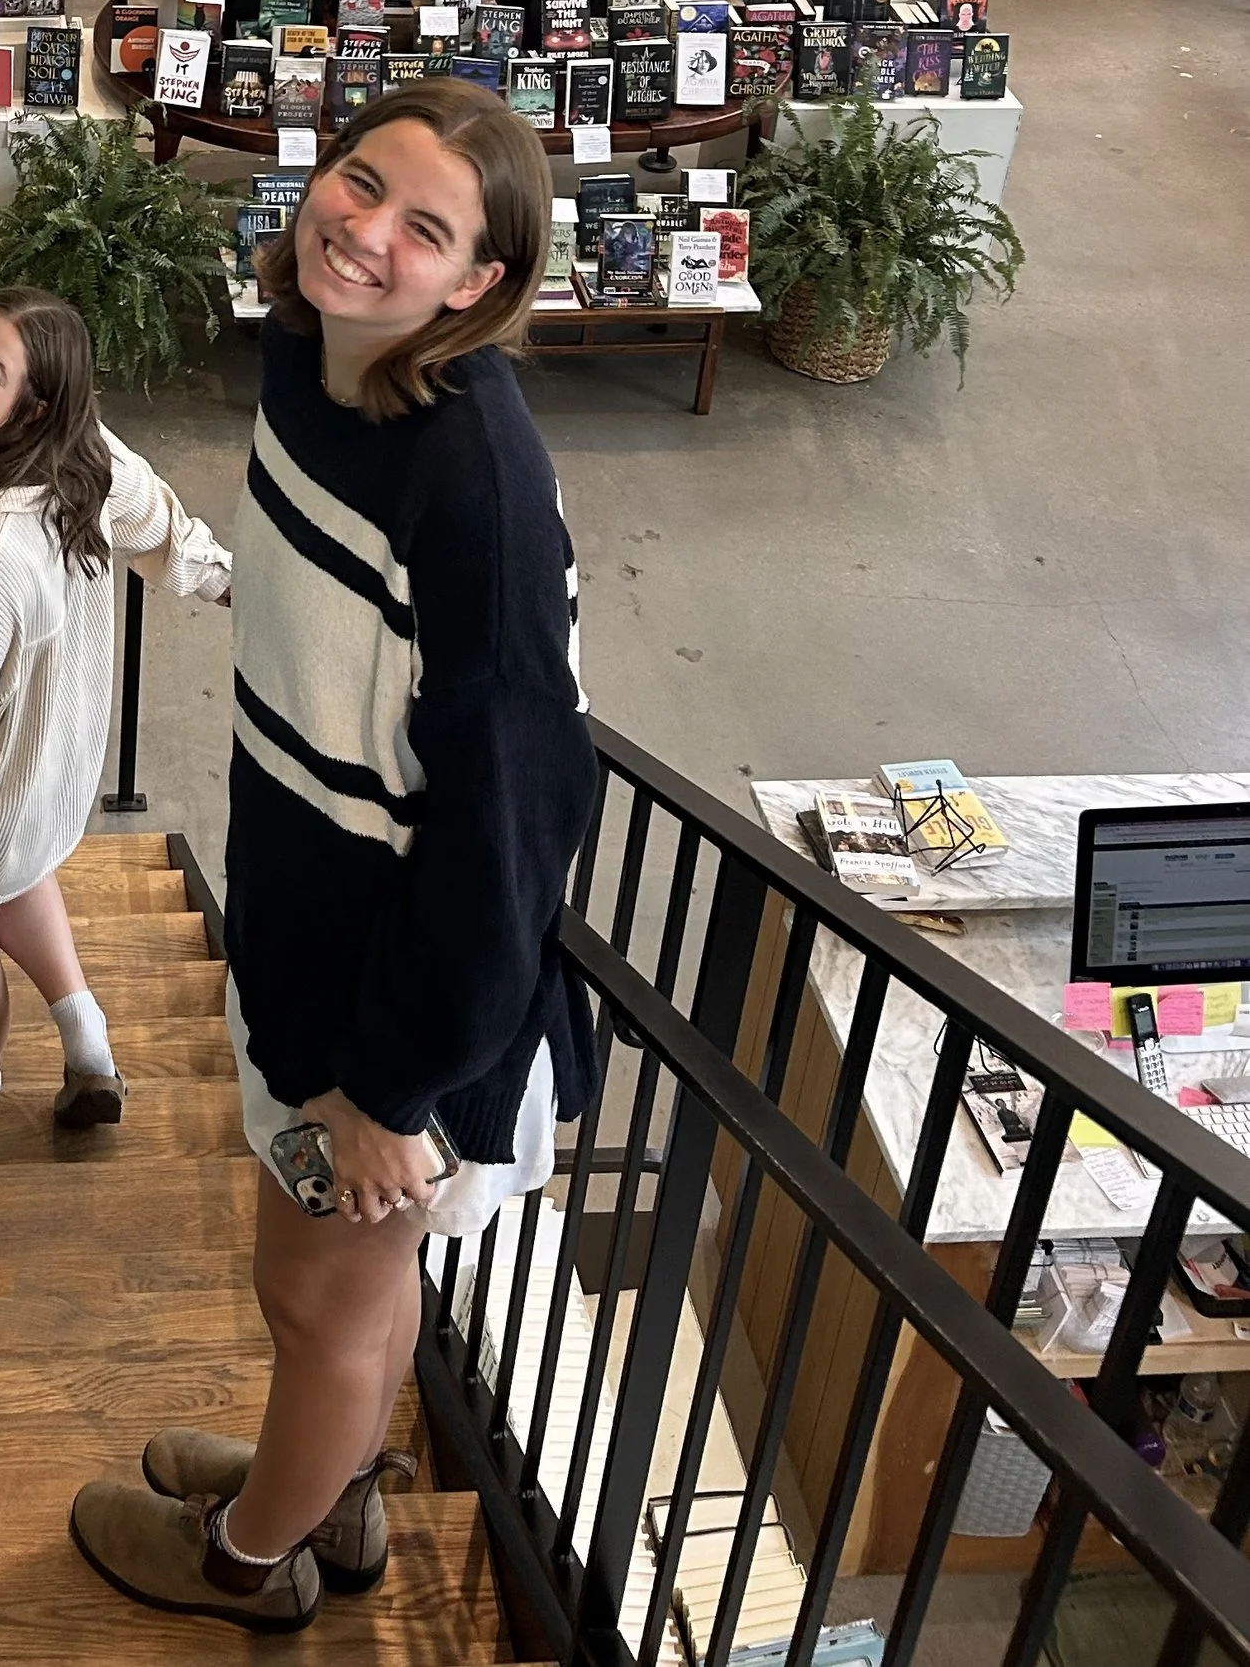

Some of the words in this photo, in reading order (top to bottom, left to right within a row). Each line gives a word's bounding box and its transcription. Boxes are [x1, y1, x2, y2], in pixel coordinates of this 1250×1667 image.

[545, 0, 588, 10] SURVIVE
[482, 10, 522, 20] STEPHEN
[556, 9, 577, 18] THE
[624, 11, 655, 19] DAPHNE
[749, 11, 794, 22] AGATHA
[481, 19, 521, 32] KING
[551, 19, 584, 29] NIGHT
[31, 32, 53, 42] BURY
[56, 32, 77, 43] OUR
[733, 31, 778, 43] AGATHA
[803, 27, 838, 39] GRADY
[343, 39, 382, 48] STEPHEN
[804, 35, 847, 48] HENDRIX
[342, 48, 381, 59] KING
[917, 43, 940, 54] THE
[388, 60, 425, 69] STEPHEN
[918, 55, 941, 69] KISS
[967, 52, 1006, 65] WEDDING
[176, 64, 190, 75] IT
[336, 63, 378, 71] STEPHEN
[621, 60, 671, 73] RESISTANCE
[28, 67, 58, 80] SOIL
[336, 72, 378, 83] KING
[390, 69, 424, 81] KING
[159, 76, 200, 89] STEPHEN
[516, 73, 551, 90] KING
[639, 76, 650, 88] OF
[159, 87, 198, 104] KING
[224, 87, 266, 99] STEPHEN
[730, 84, 776, 96] CHRISTIE
[626, 90, 664, 103] WITCHES
[278, 111, 314, 119] PROJECT
[262, 191, 300, 203] DEATH
[247, 215, 270, 231] LISA
[678, 270, 711, 282] GOOD
[872, 817, 899, 831] Hill
[839, 857, 872, 867] Francis
